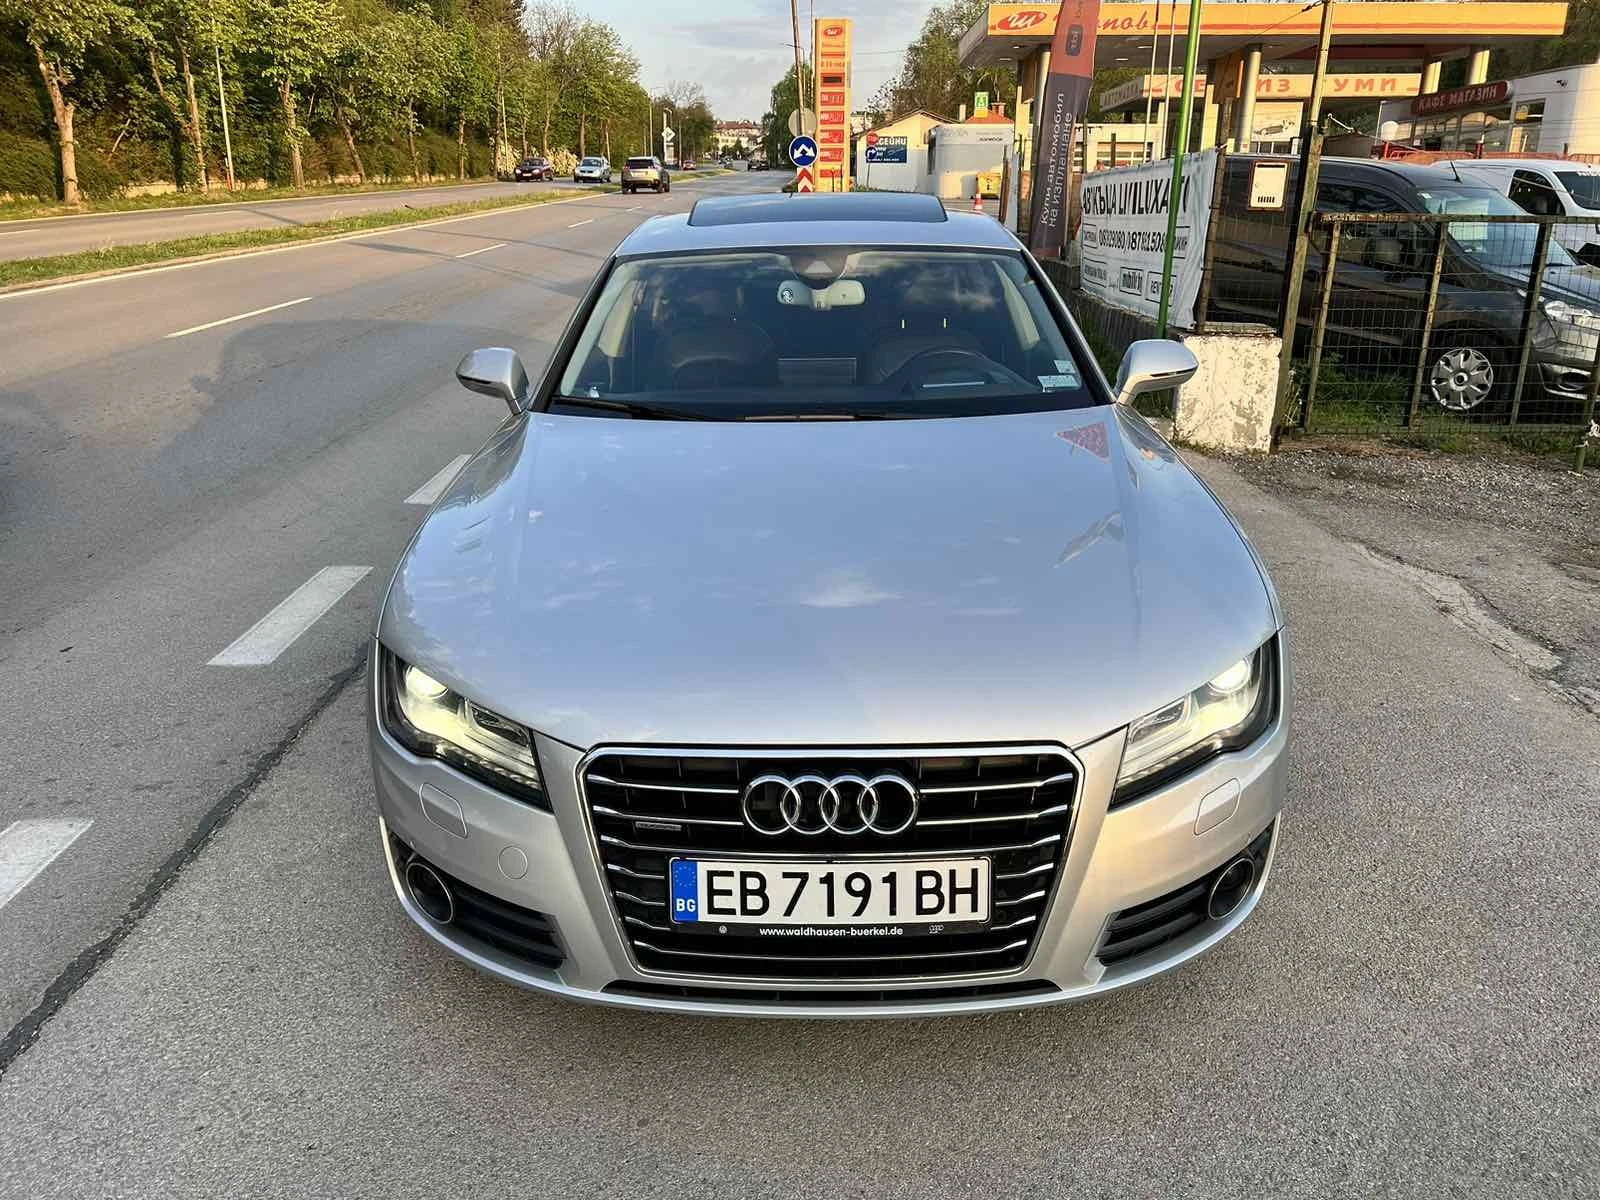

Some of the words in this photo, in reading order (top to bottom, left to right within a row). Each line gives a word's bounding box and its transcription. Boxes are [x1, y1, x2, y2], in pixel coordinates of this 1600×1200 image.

[1417, 97, 1446, 112] КАФЕ
[1448, 86, 1498, 106] МАГАЗИН
[1040, 186, 1052, 225] Купи
[1046, 92, 1065, 182] автомобил
[1053, 112, 1073, 203] изплащане
[1049, 208, 1060, 227] на
[676, 898, 696, 912] BG
[706, 869, 771, 916] EB
[781, 871, 897, 917] 7191
[916, 867, 979, 916] BH
[759, 925, 904, 937] www.waldhausen-buerkel.de
